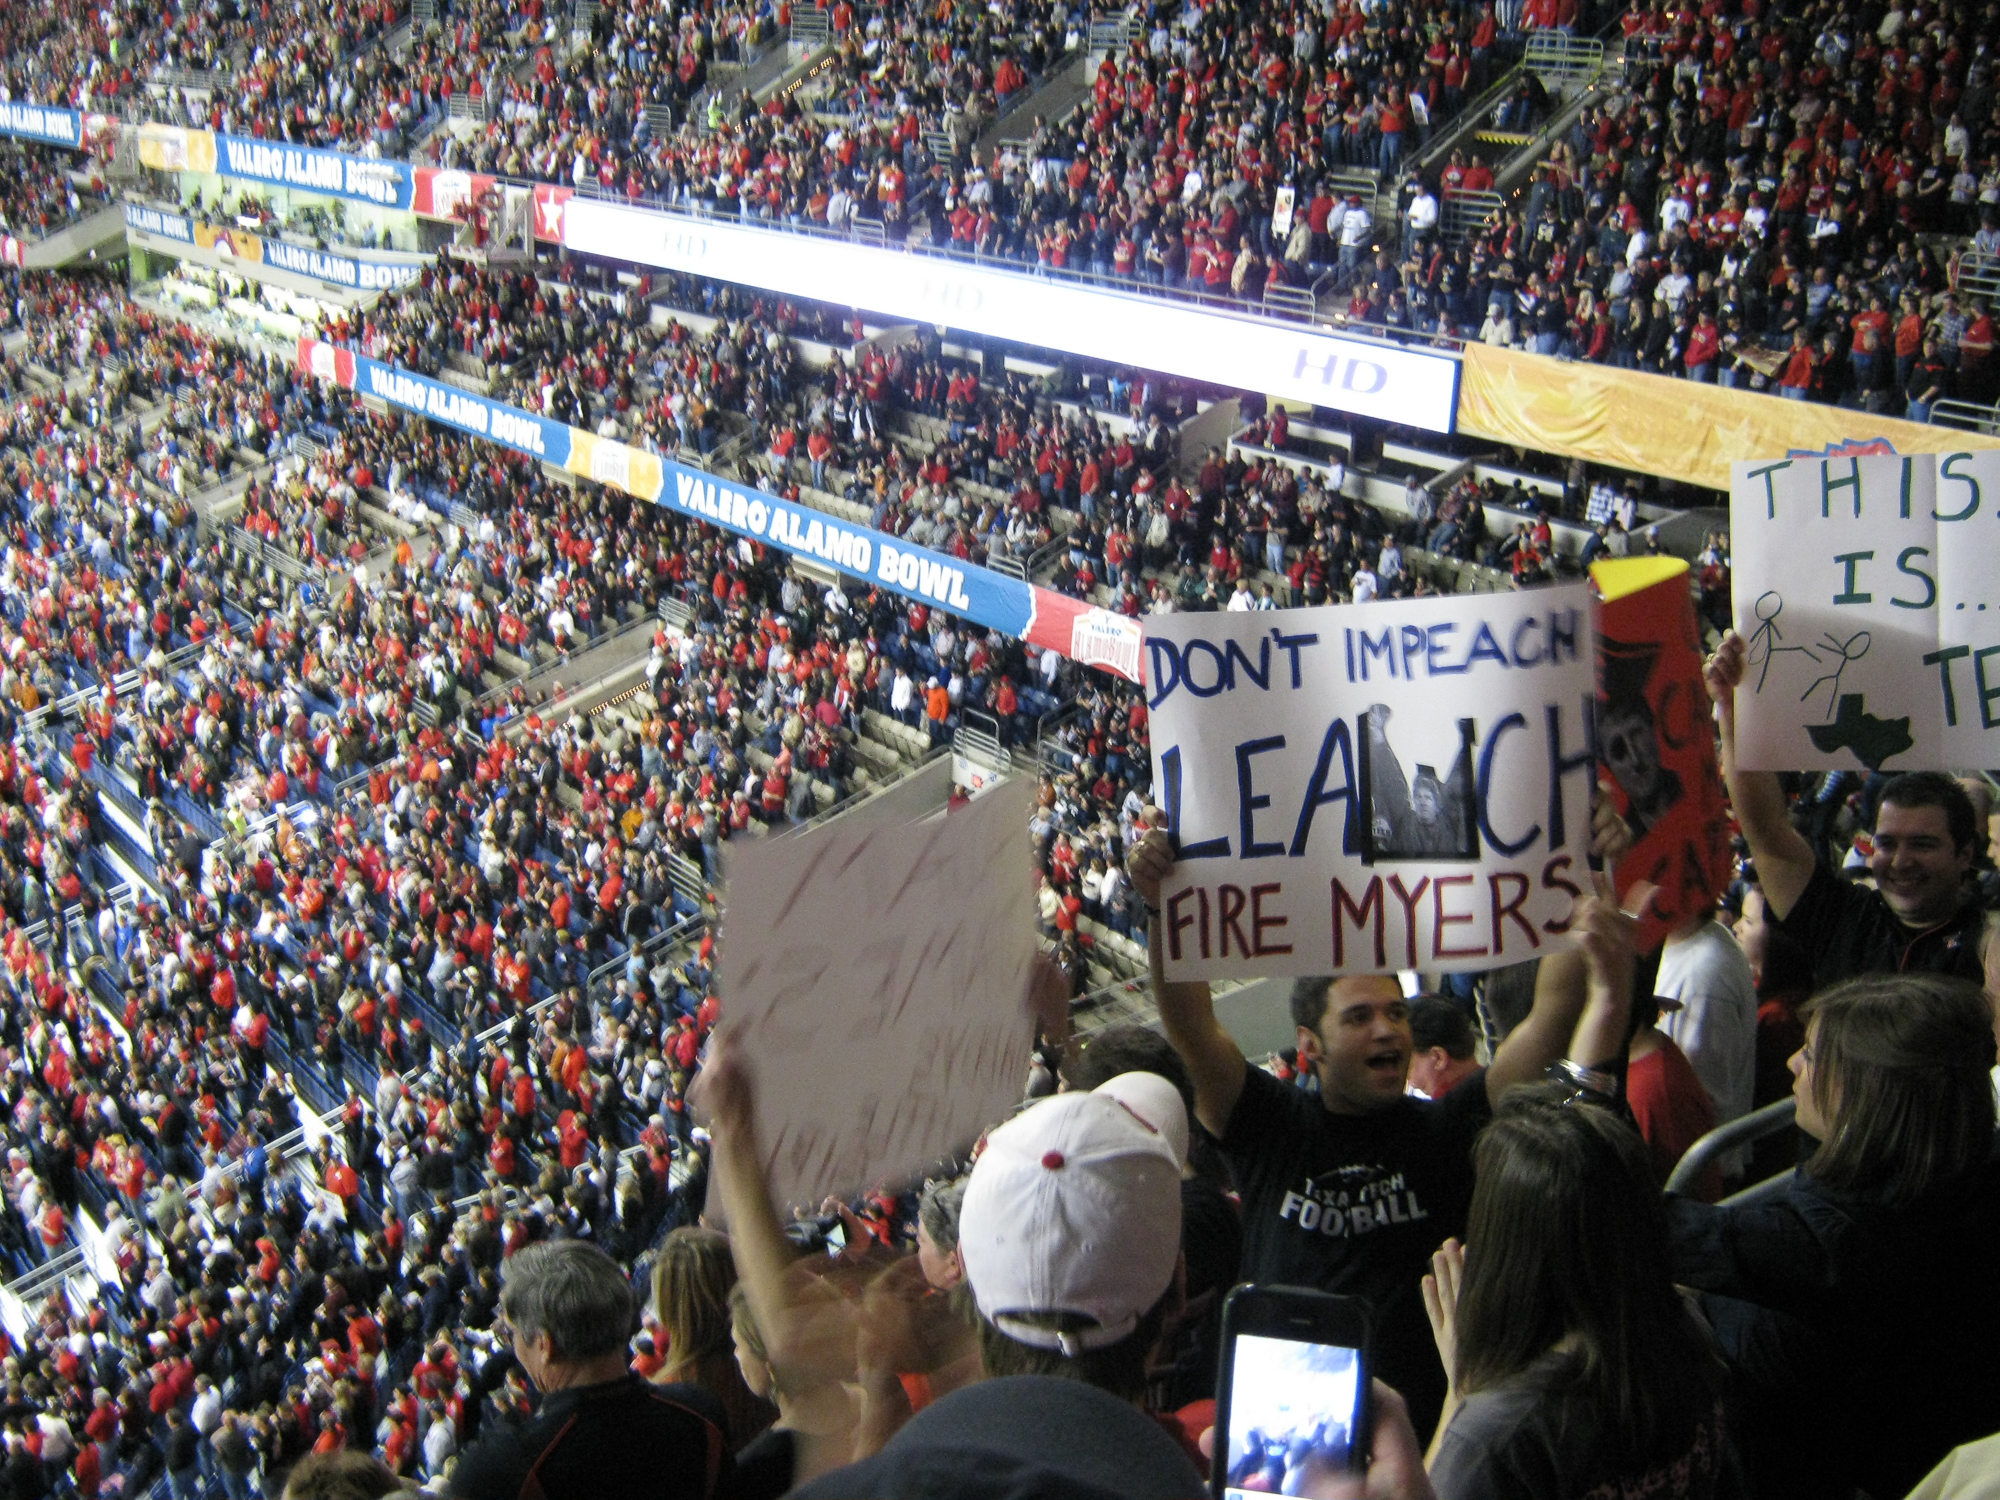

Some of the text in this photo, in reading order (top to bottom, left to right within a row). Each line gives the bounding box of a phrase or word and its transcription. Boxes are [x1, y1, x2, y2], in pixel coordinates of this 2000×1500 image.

[226, 140, 283, 180] VALERO
[284, 150, 343, 190] ALAMO
[267, 240, 420, 290] VALERO ALAMO BOW
[663, 229, 708, 257] HD
[1293, 348, 1389, 394] HD
[369, 365, 545, 456] VALERO ALAMO BOWL
[675, 471, 970, 612] VALERO ALAMO BOWL
[1143, 608, 1582, 710] DON'T IMPEACH
[1165, 855, 1585, 969] FIRE MYERS
